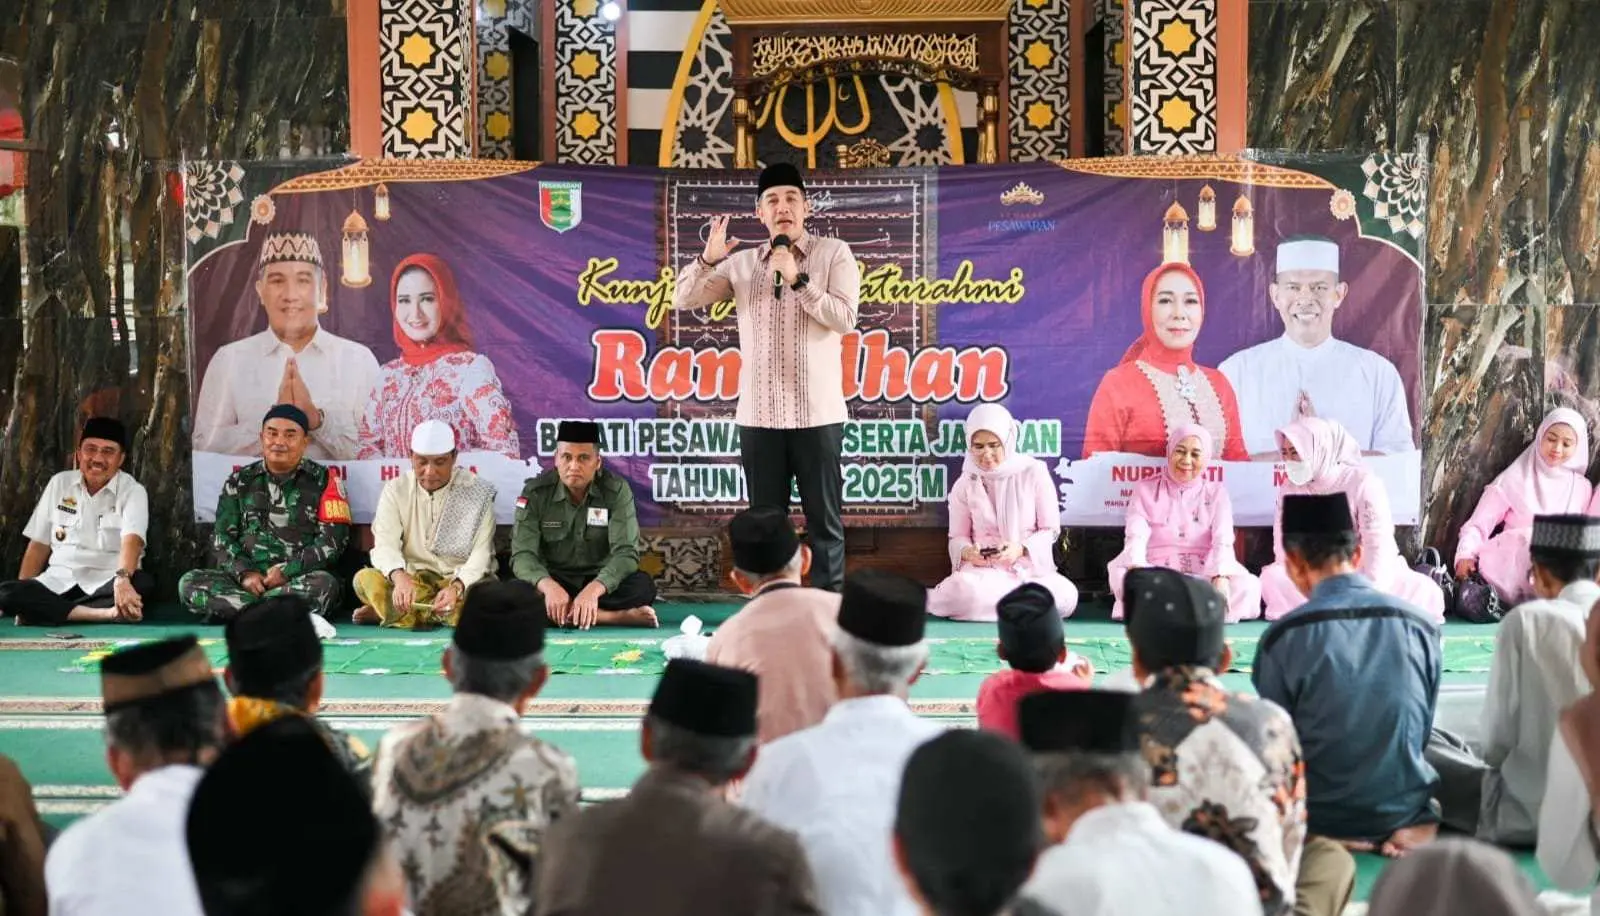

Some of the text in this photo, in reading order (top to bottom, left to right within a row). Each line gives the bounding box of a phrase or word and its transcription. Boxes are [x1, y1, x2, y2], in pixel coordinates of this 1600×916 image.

[857, 259, 1025, 305] aturahmi
[538, 420, 1059, 454] BATI PESAWA SERTA JAAN
[651, 466, 738, 499] TAHUN
[844, 466, 914, 499] 2025
[919, 466, 945, 499] M
